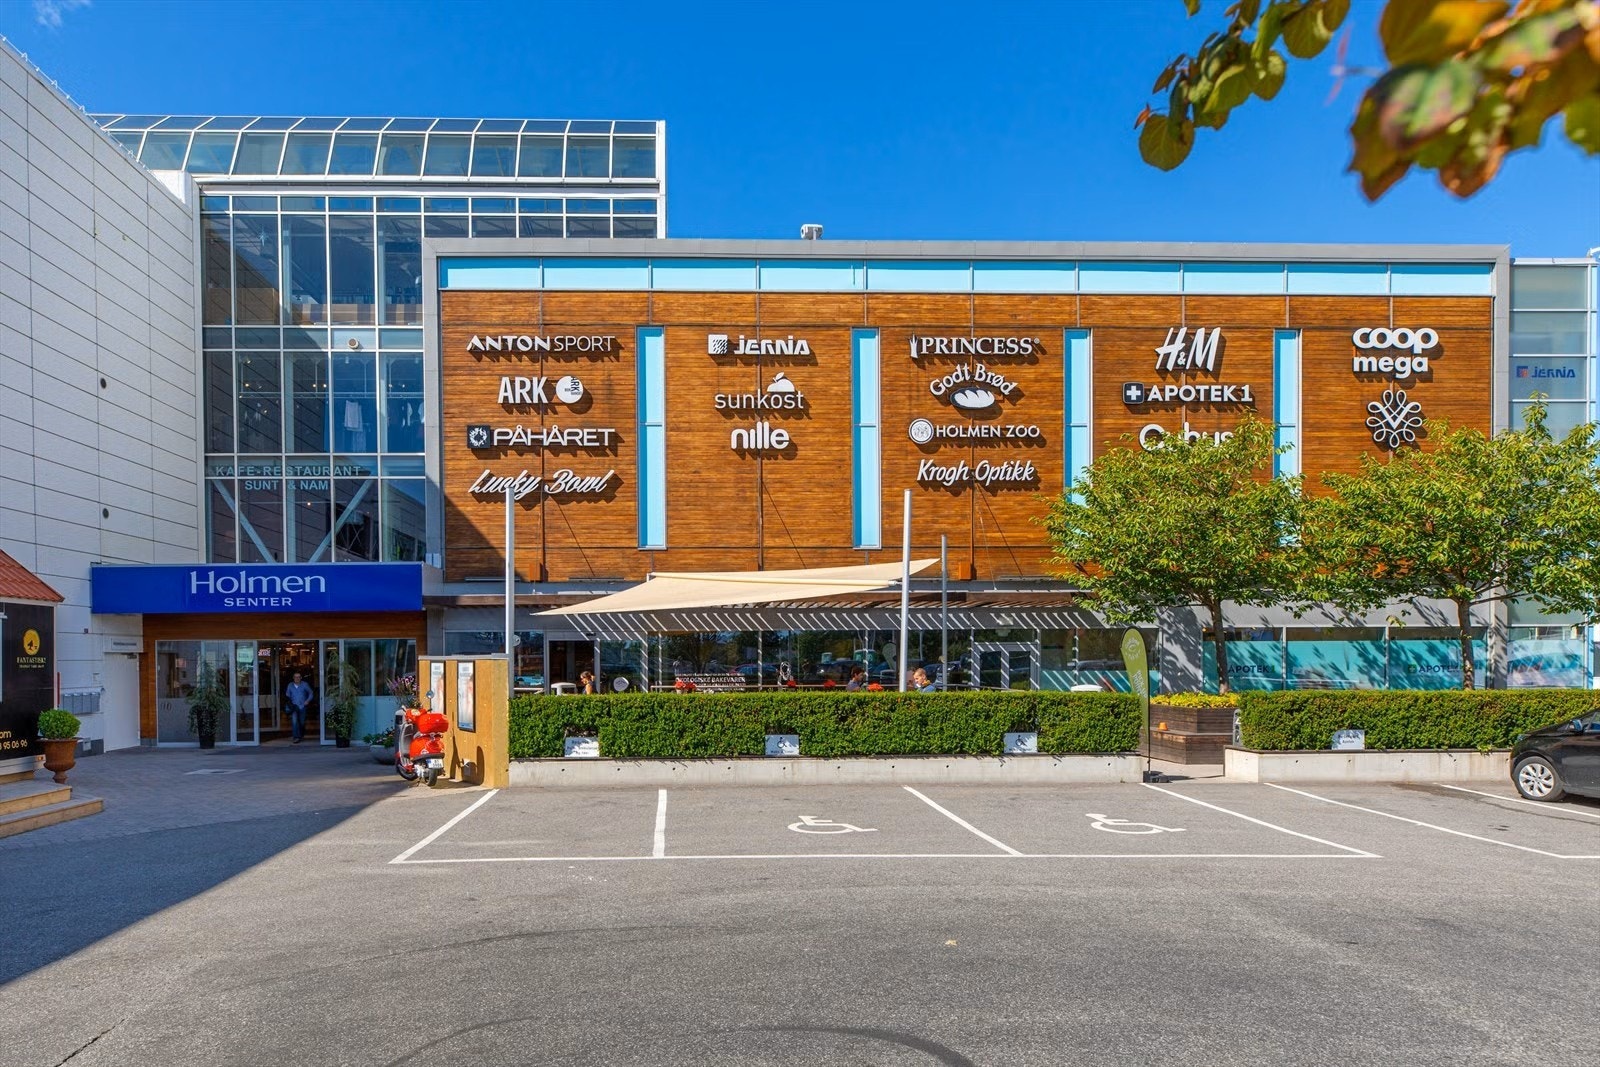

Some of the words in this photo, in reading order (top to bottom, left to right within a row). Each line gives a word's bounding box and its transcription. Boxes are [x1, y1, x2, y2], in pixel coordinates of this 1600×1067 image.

[920, 337, 1033, 355] PRINCESS
[1155, 327, 1221, 371] H&M
[1352, 327, 1439, 354] coop
[1353, 356, 1429, 379] mega
[498, 376, 548, 403] ARK
[930, 363, 971, 396] Godt
[974, 364, 1018, 395] Brød
[714, 389, 804, 409] sunkost
[1147, 385, 1238, 402] APOTEK
[493, 425, 615, 446] PÅHÅRET
[731, 421, 789, 449] nille
[936, 425, 1001, 438] HOLMEN
[1006, 425, 1040, 438] ZOO
[1139, 421, 1234, 452] Cbus
[917, 459, 969, 486] Krogh
[975, 460, 1035, 486] Optikk
[245, 480, 278, 491] SUNT
[300, 480, 329, 490] NAM
[468, 469, 541, 500] Lucky
[544, 469, 615, 494] Bowl
[190, 570, 326, 594] Holmen
[224, 597, 292, 607] SENTER
[1228, 665, 1269, 673] APOTEK
[11, 740, 20, 749] 06
[20, 739, 28, 748] 96
